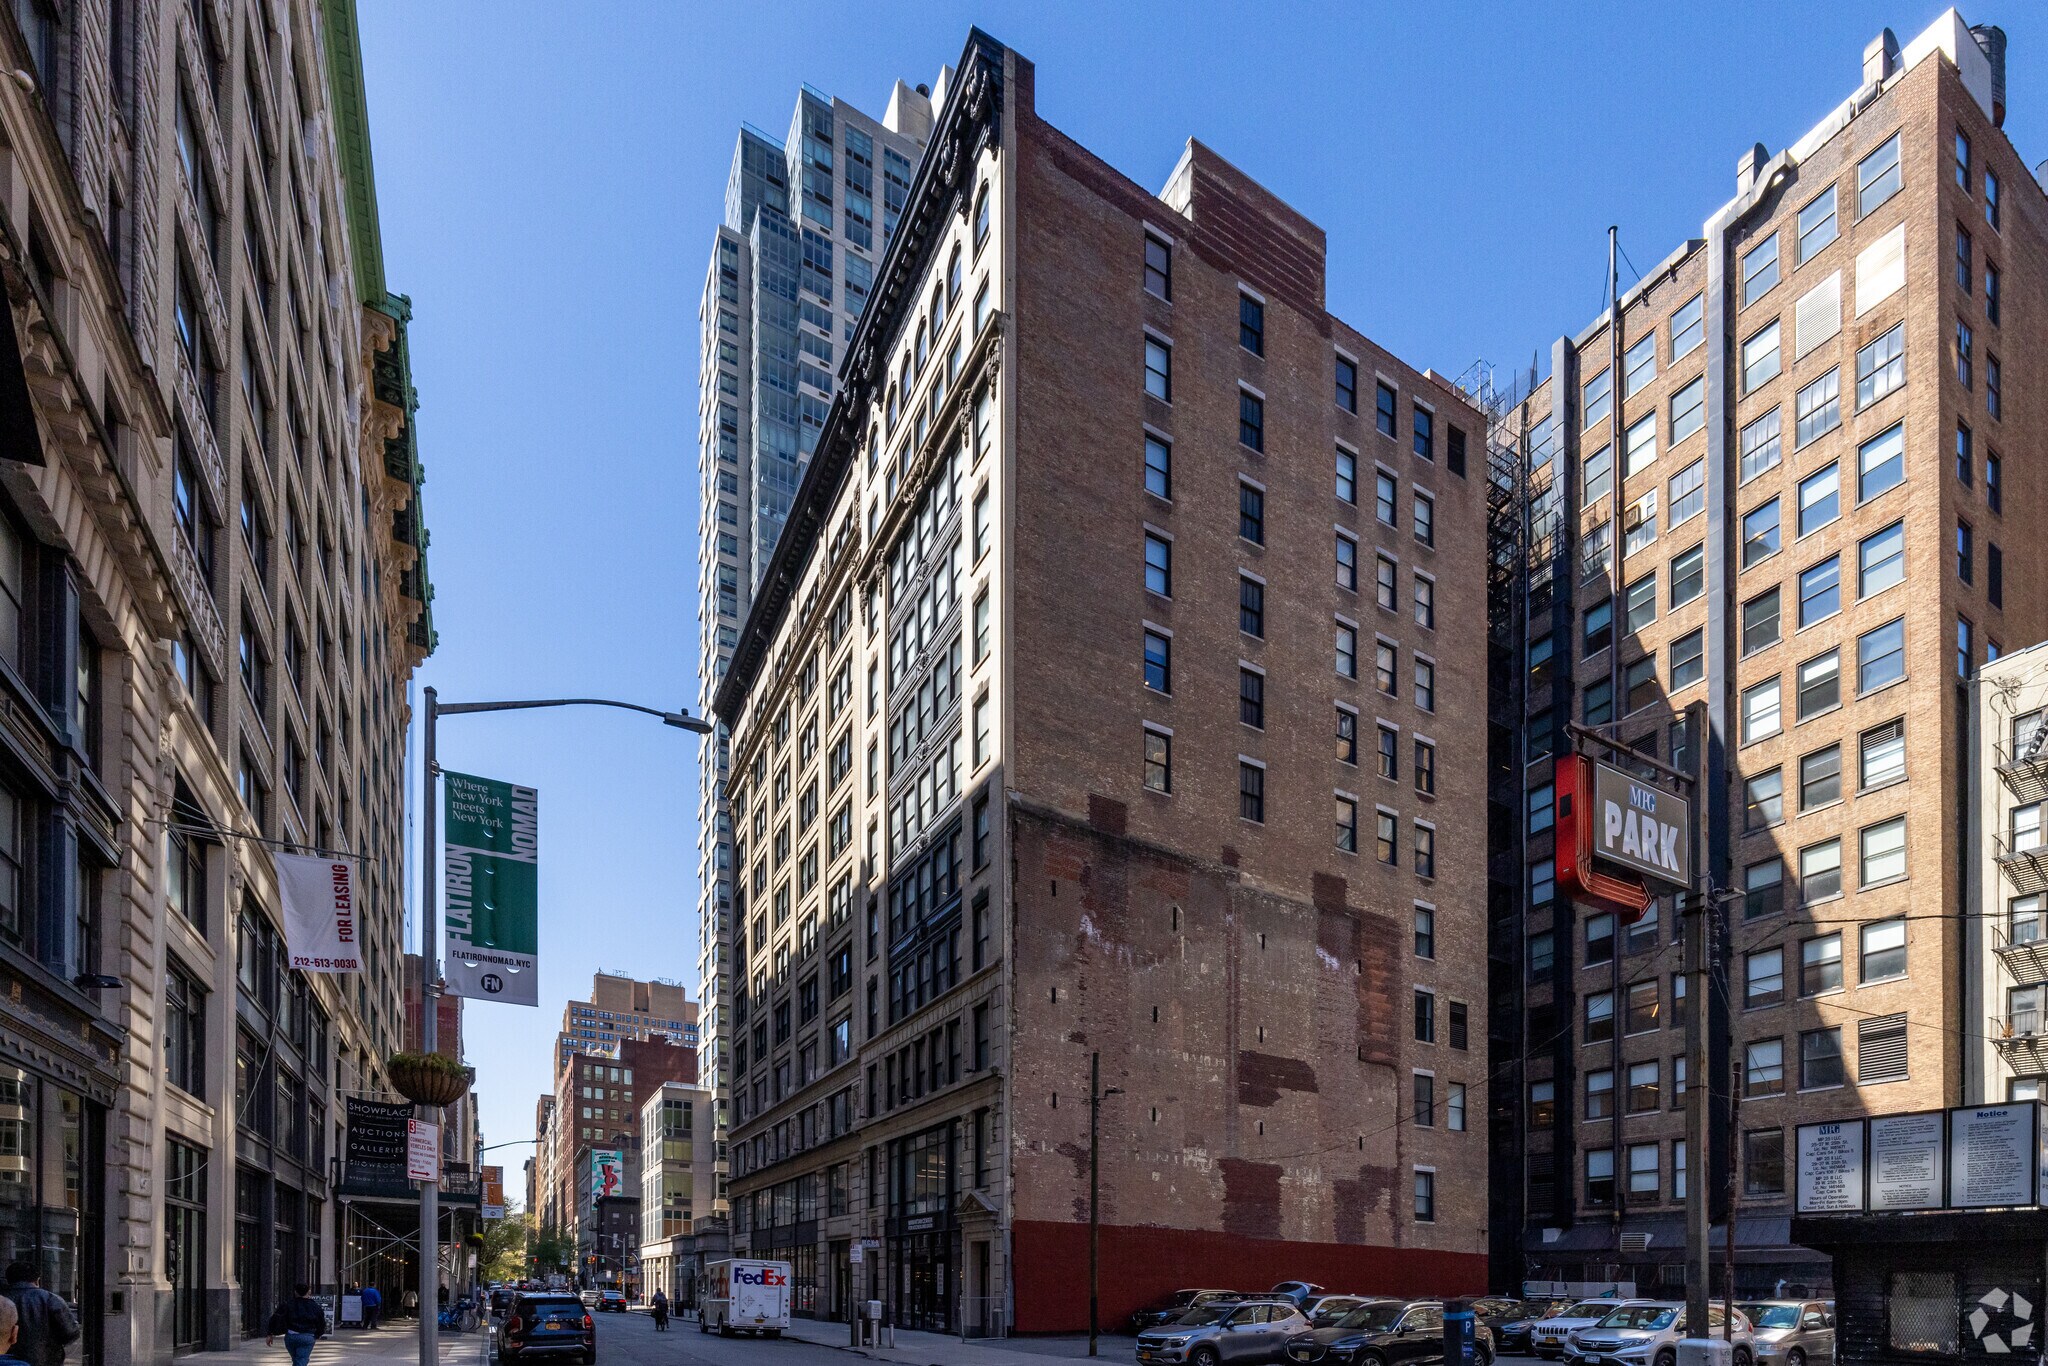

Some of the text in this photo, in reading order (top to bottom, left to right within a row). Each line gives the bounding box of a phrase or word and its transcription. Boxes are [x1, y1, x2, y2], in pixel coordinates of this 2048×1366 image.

[452, 778, 488, 793] Where
[452, 789, 503, 808] New York
[452, 801, 485, 814] meets
[452, 810, 503, 829] New York
[512, 784, 537, 864] NOMAD
[1605, 800, 1679, 873] PARK
[445, 843, 472, 946] FLATIRON
[331, 864, 354, 943] FOR LEASING
[294, 956, 358, 969] 212-513-0030
[452, 950, 531, 969] FLATIRONNOMAD.NYC
[483, 977, 500, 991] FN
[348, 1102, 412, 1117] SHOWPLACE
[1976, 1110, 2008, 1118] Notice
[352, 1126, 406, 1138] AUCTIONS
[410, 1122, 416, 1132] 3
[351, 1143, 404, 1154] GALLERIES
[734, 1267, 786, 1286] FedEx
[1466, 1321, 1471, 1333] P
